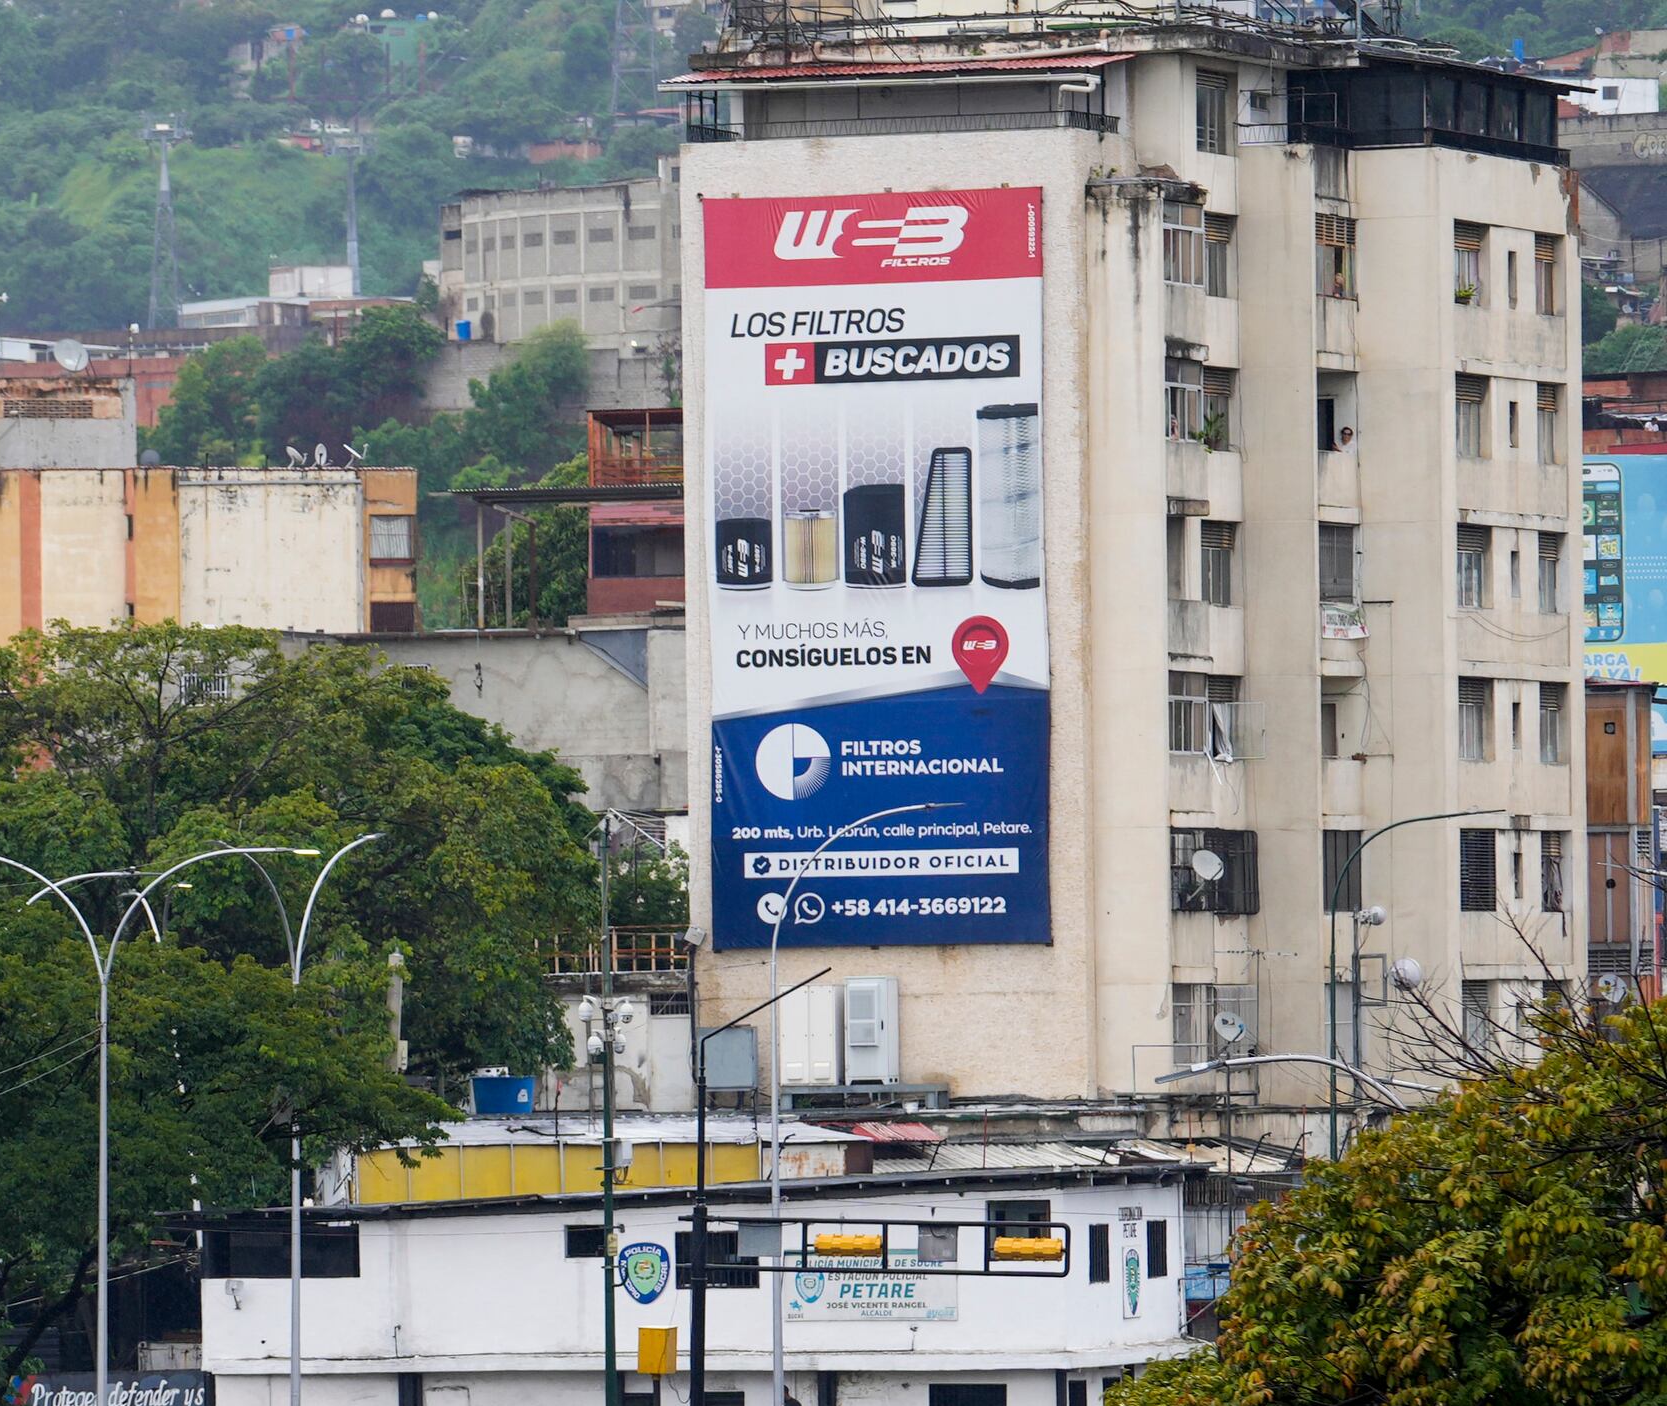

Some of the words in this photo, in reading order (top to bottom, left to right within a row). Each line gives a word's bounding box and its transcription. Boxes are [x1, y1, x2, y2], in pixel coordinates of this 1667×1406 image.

[730, 311, 785, 338] LOS
[791, 308, 906, 336] FILTROS
[824, 342, 1012, 377] BUSCADOS
[738, 624, 750, 640] Y
[755, 622, 838, 639] MUCHOS
[844, 617, 889, 640] MÁS,
[736, 643, 898, 668] CONSÍGUELOS
[902, 645, 932, 664] EN
[841, 740, 922, 756] FILTROS
[841, 757, 1004, 776] INTERNACIONAL
[732, 827, 761, 840] 200
[764, 827, 794, 841] mts,
[797, 825, 826, 838] Urb.
[883, 823, 915, 837] calle
[919, 822, 980, 841] principal,
[983, 821, 1033, 835] Petare.
[779, 857, 921, 871] DISTRIBUIDOR
[929, 854, 1009, 869] OFICIAL
[831, 898, 870, 916] +58
[873, 896, 1006, 915] 414-3669122
[839, 1282, 917, 1299] PETARE
